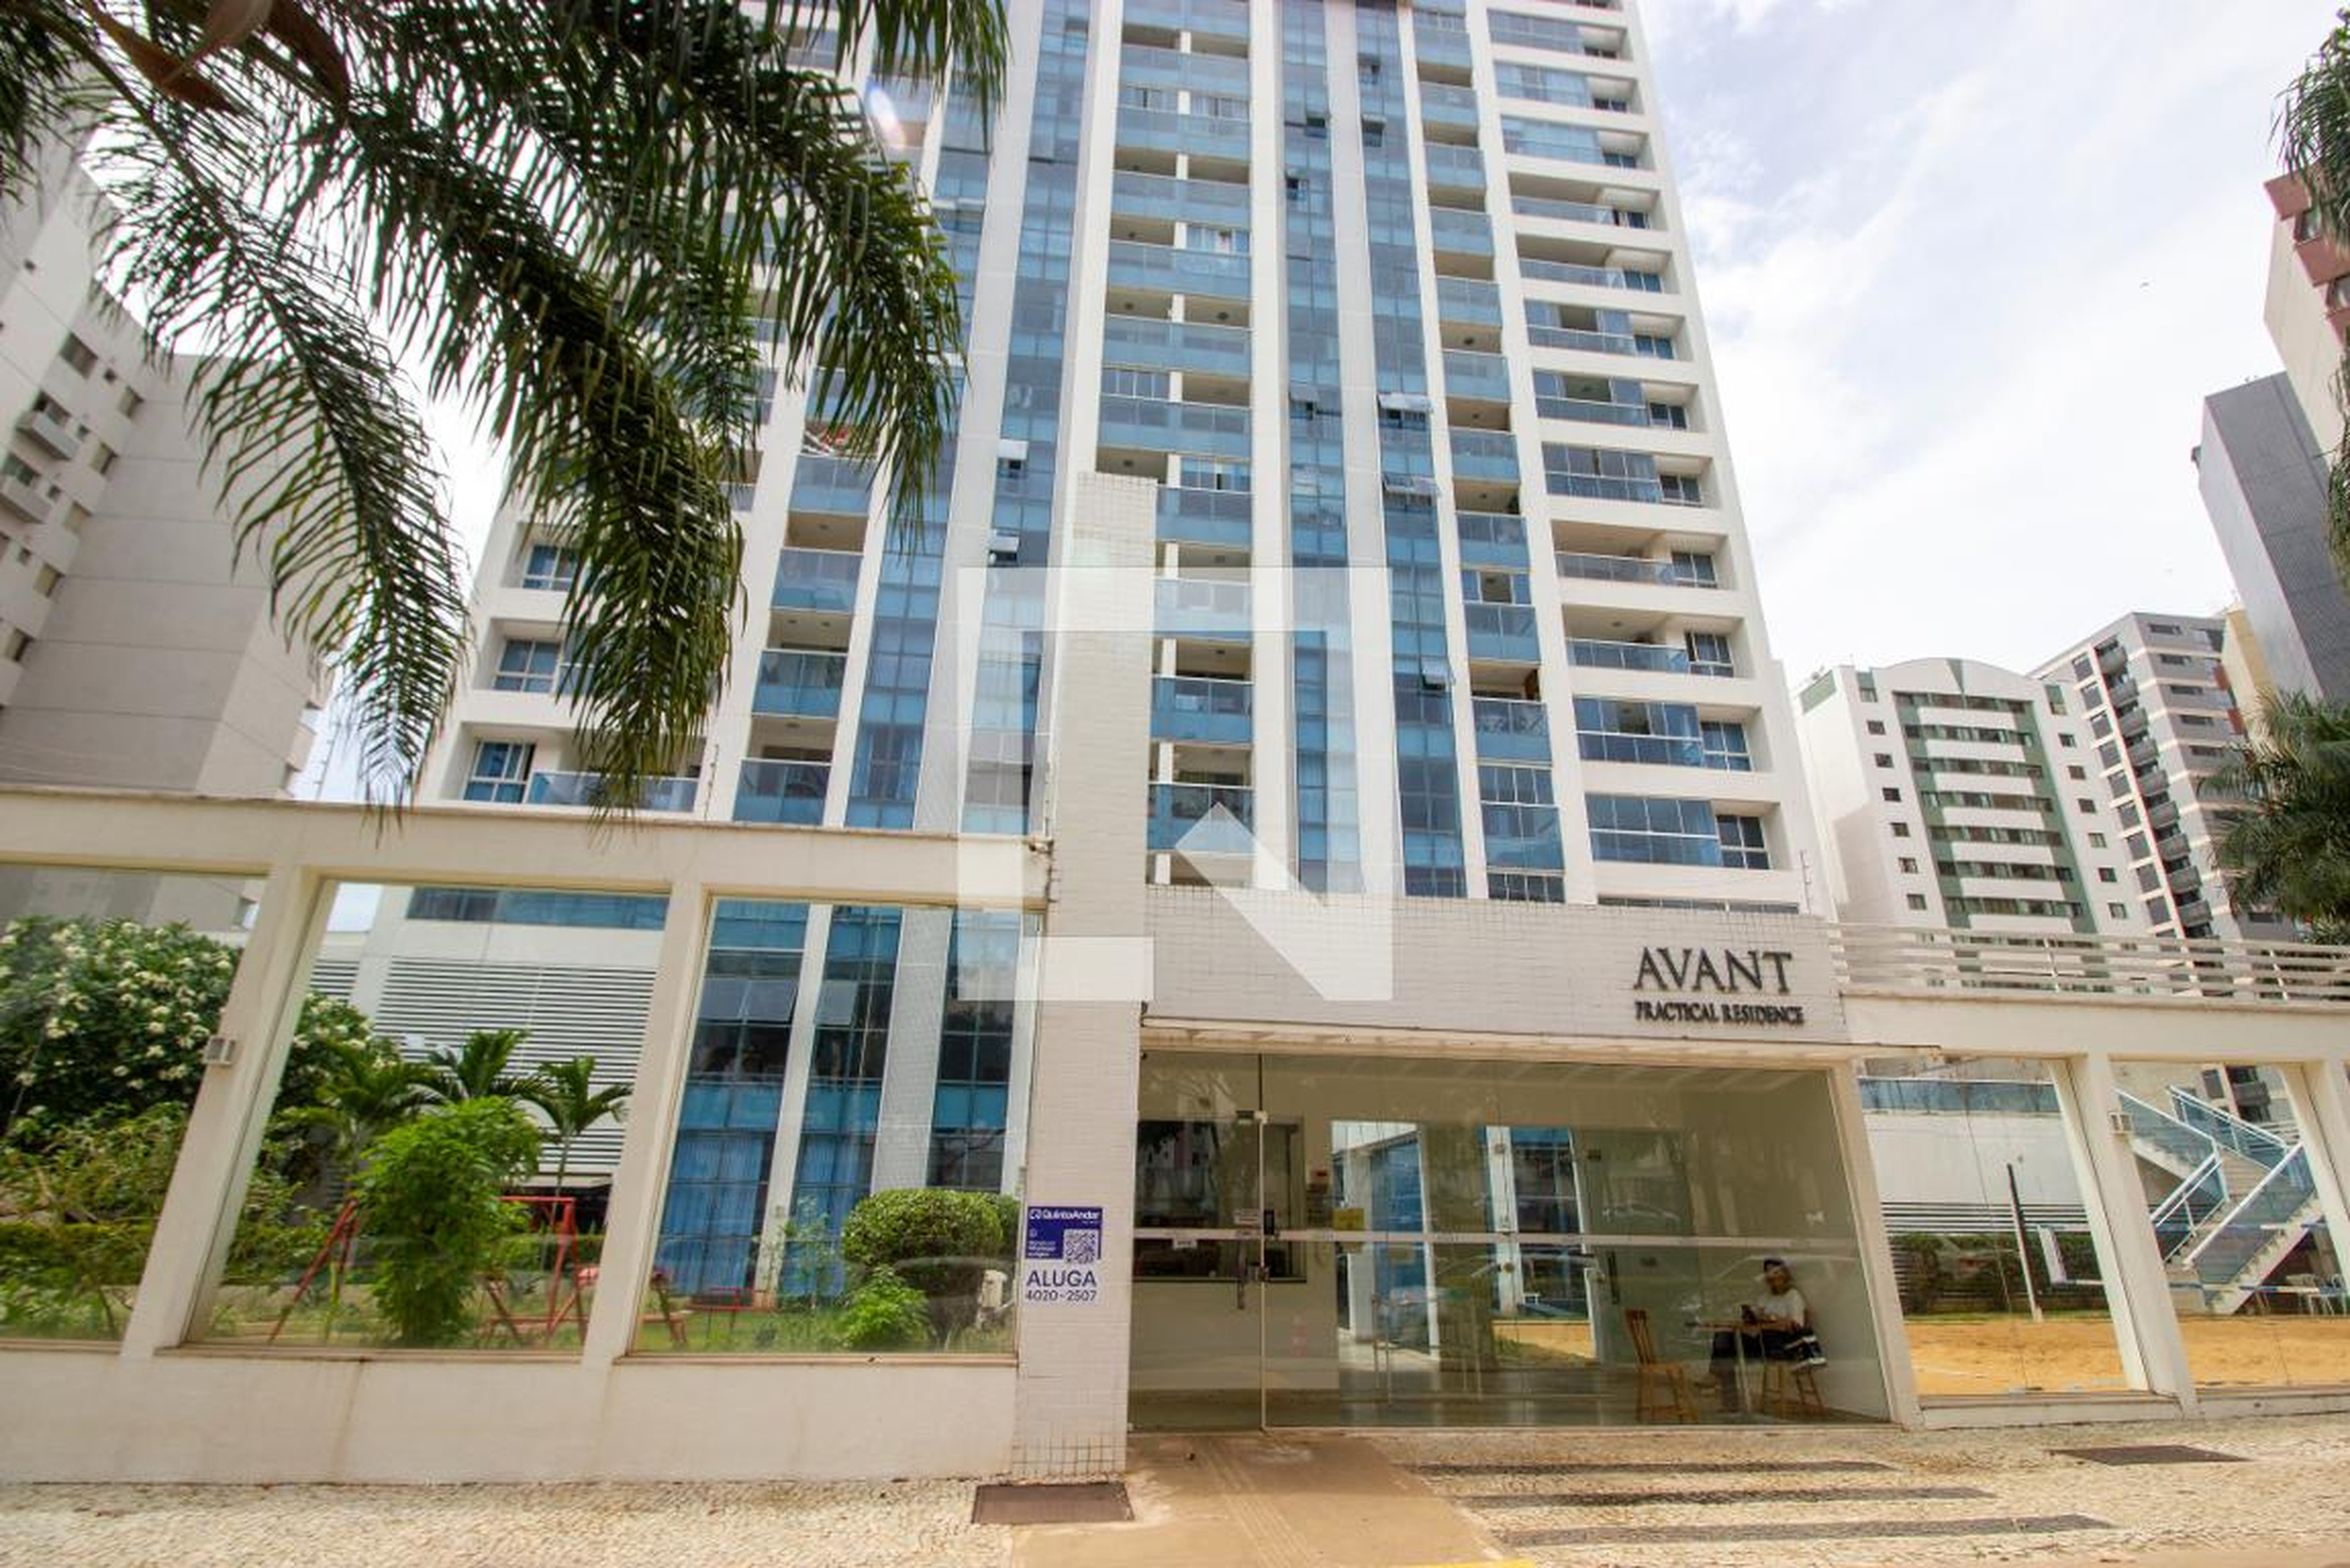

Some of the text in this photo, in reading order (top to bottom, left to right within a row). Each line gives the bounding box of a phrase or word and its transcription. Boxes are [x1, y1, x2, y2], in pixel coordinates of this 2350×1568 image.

[1633, 946, 1792, 993] AVANT
[1635, 1001, 1804, 1025] PRACTICAL RESIDENCE
[1043, 1209, 1099, 1220] QuintoAndar
[1026, 1270, 1097, 1286] ALUGA
